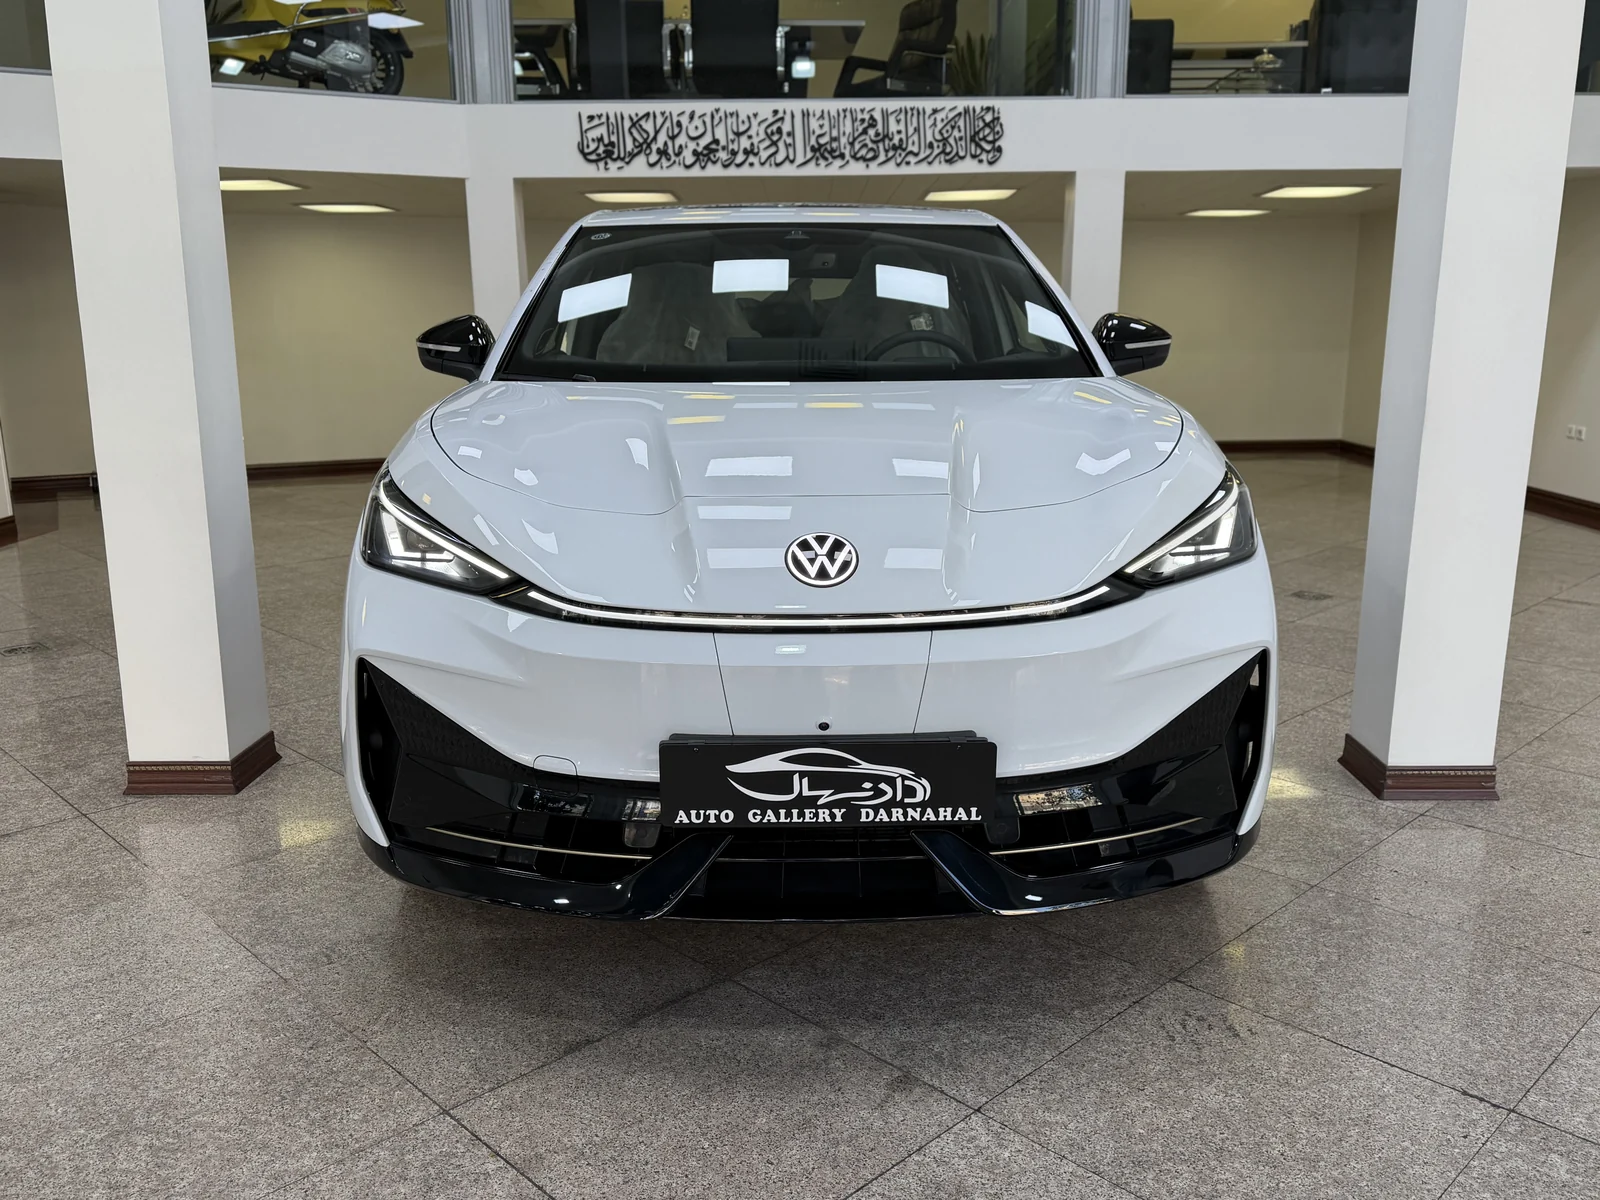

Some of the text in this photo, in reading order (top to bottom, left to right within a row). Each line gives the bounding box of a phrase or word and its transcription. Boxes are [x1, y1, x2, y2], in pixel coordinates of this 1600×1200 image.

[789, 535, 853, 579] VW
[674, 807, 982, 824] AUTO GALLERY DARNAHAL
